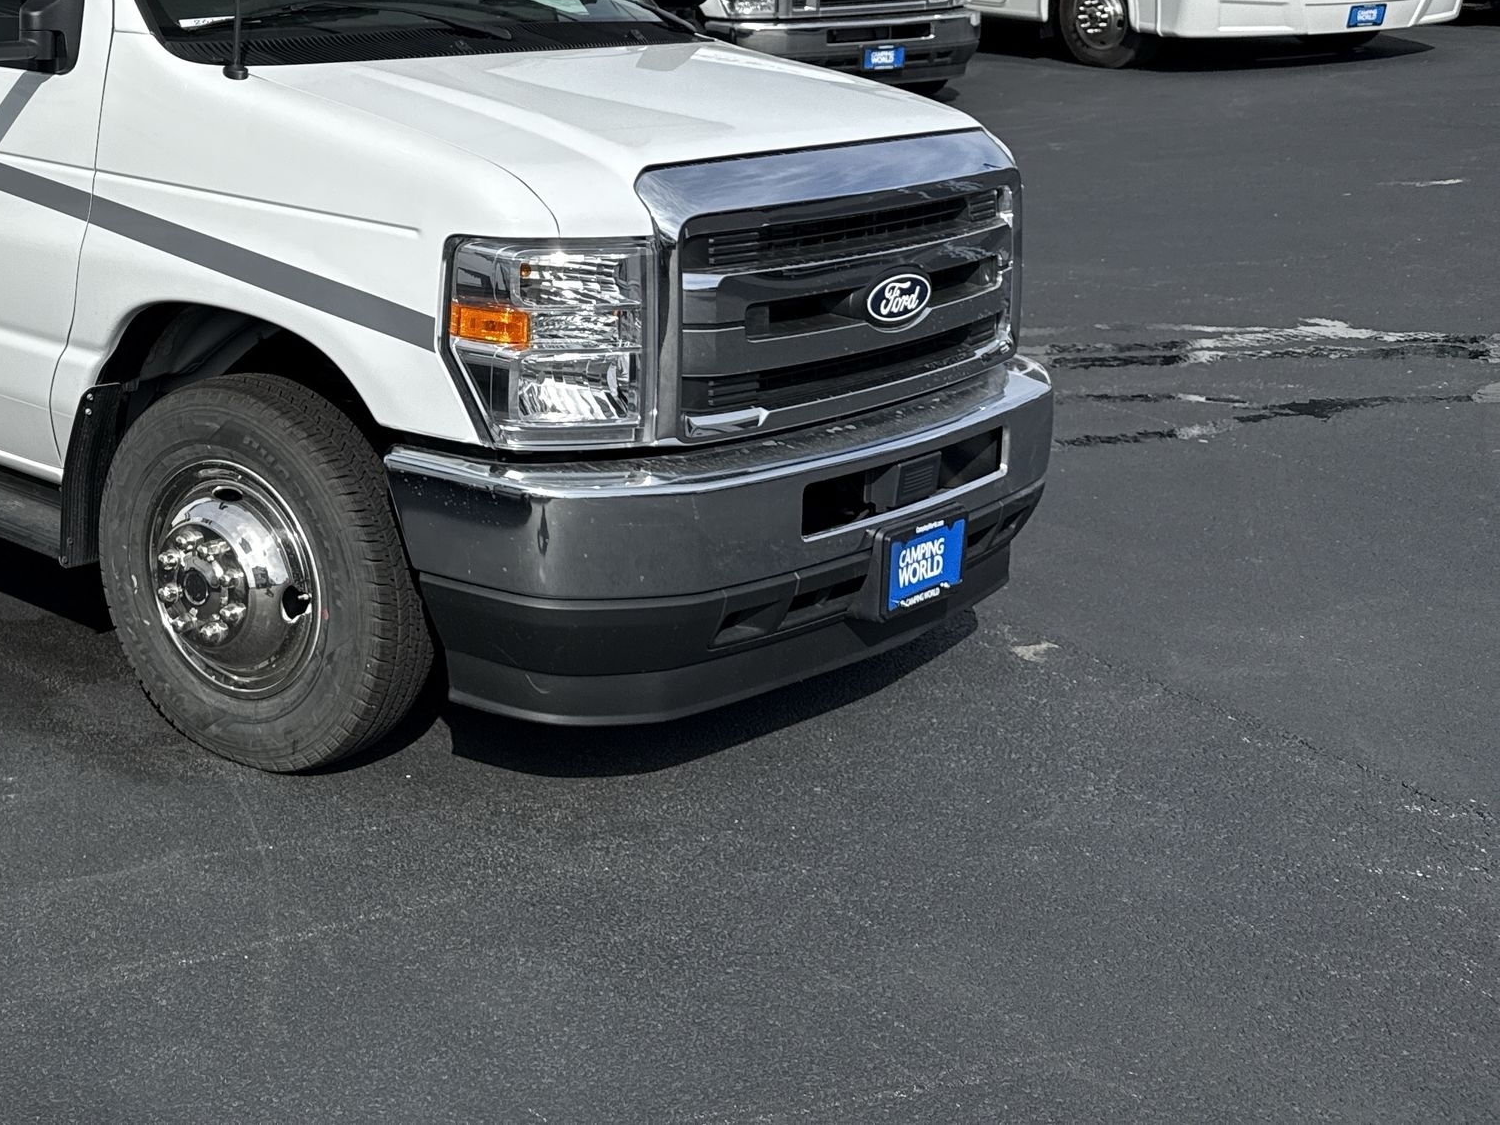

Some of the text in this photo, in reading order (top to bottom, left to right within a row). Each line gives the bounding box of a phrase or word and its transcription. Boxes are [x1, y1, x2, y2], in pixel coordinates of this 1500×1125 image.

[880, 281, 920, 315] Ford
[899, 537, 945, 567] CAMPING
[898, 555, 944, 588] WORLD
